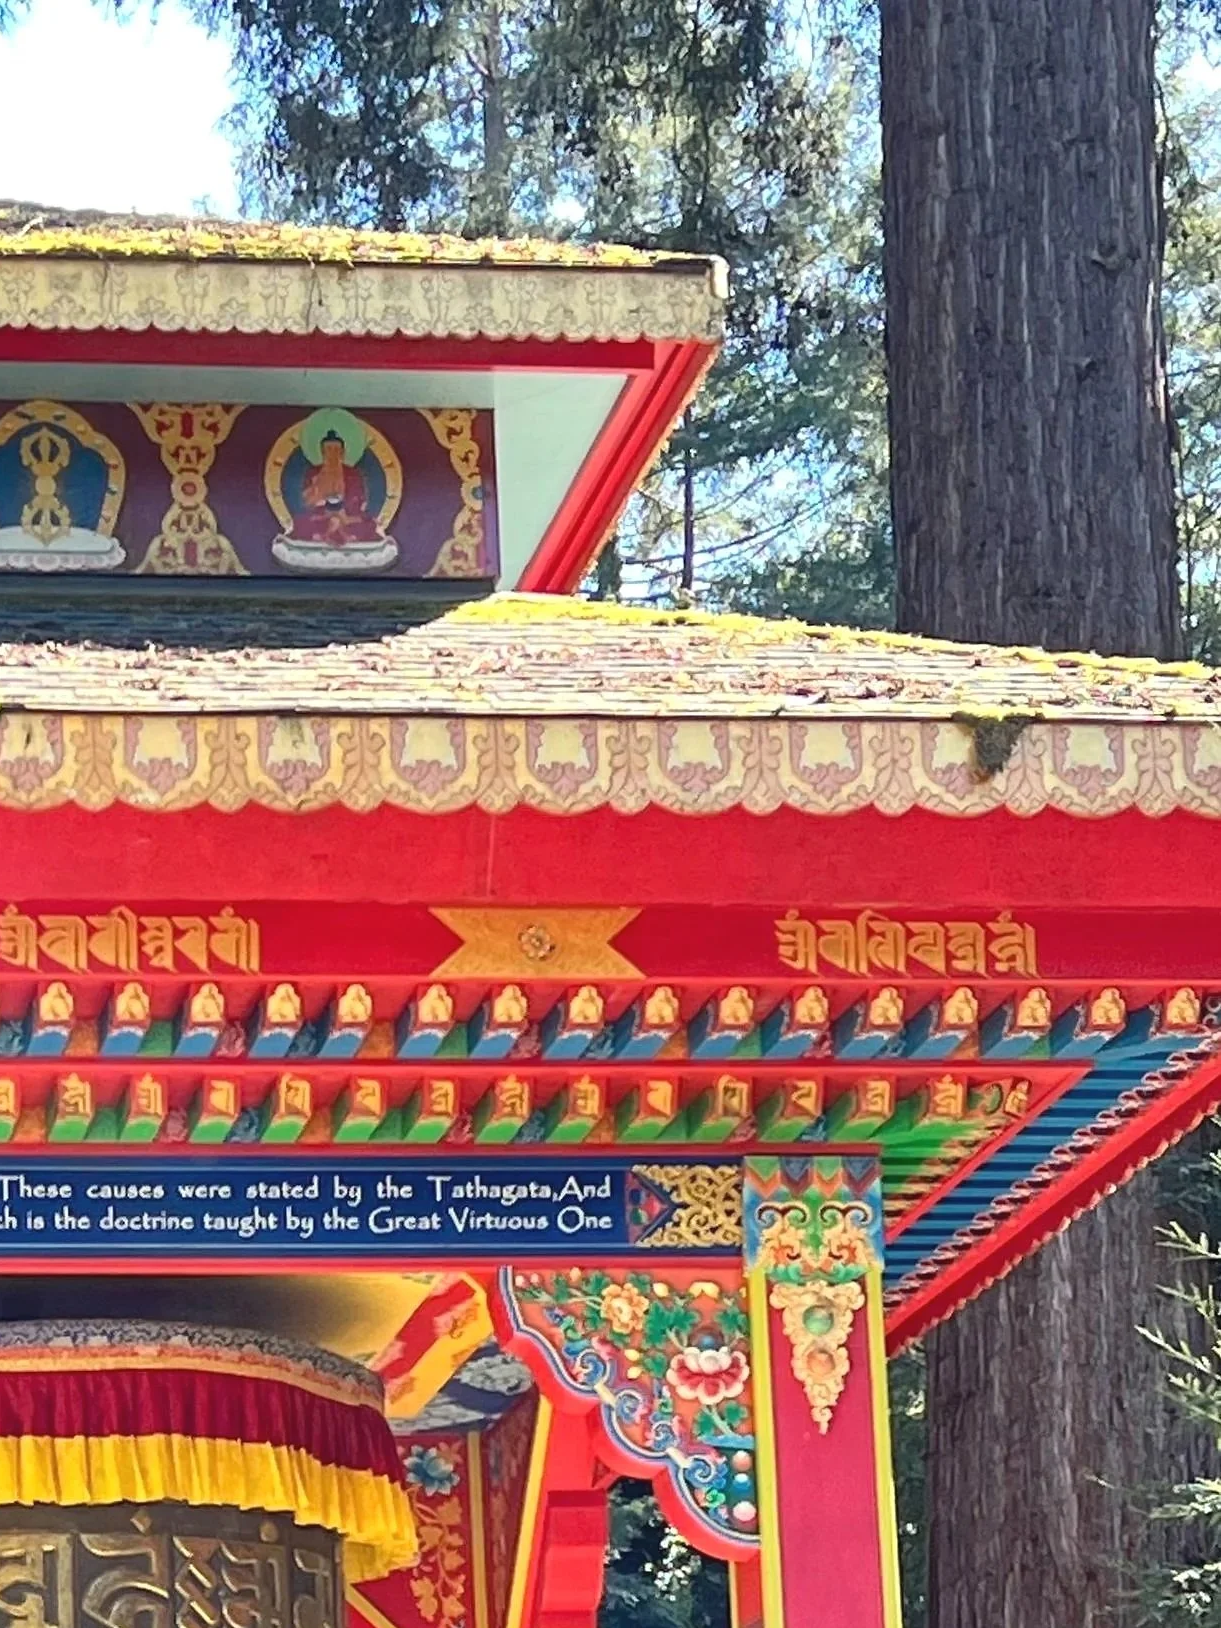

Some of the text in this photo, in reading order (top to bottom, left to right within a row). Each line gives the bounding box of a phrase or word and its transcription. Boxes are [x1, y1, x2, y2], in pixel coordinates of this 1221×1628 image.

[86, 1184, 165, 1198] causes
[178, 1184, 231, 1199] were
[246, 1175, 319, 1199] stated
[333, 1175, 362, 1207] by
[376, 1174, 413, 1199] the
[26, 1211, 45, 1230] is
[54, 1205, 91, 1230] the
[99, 1205, 195, 1230] doctrine
[203, 1205, 278, 1238] taught
[285, 1205, 314, 1239] by
[322, 1206, 360, 1230] the
[368, 1206, 441, 1234] Great
[448, 1206, 549, 1233] Virtuous
[557, 1205, 613, 1234] One
